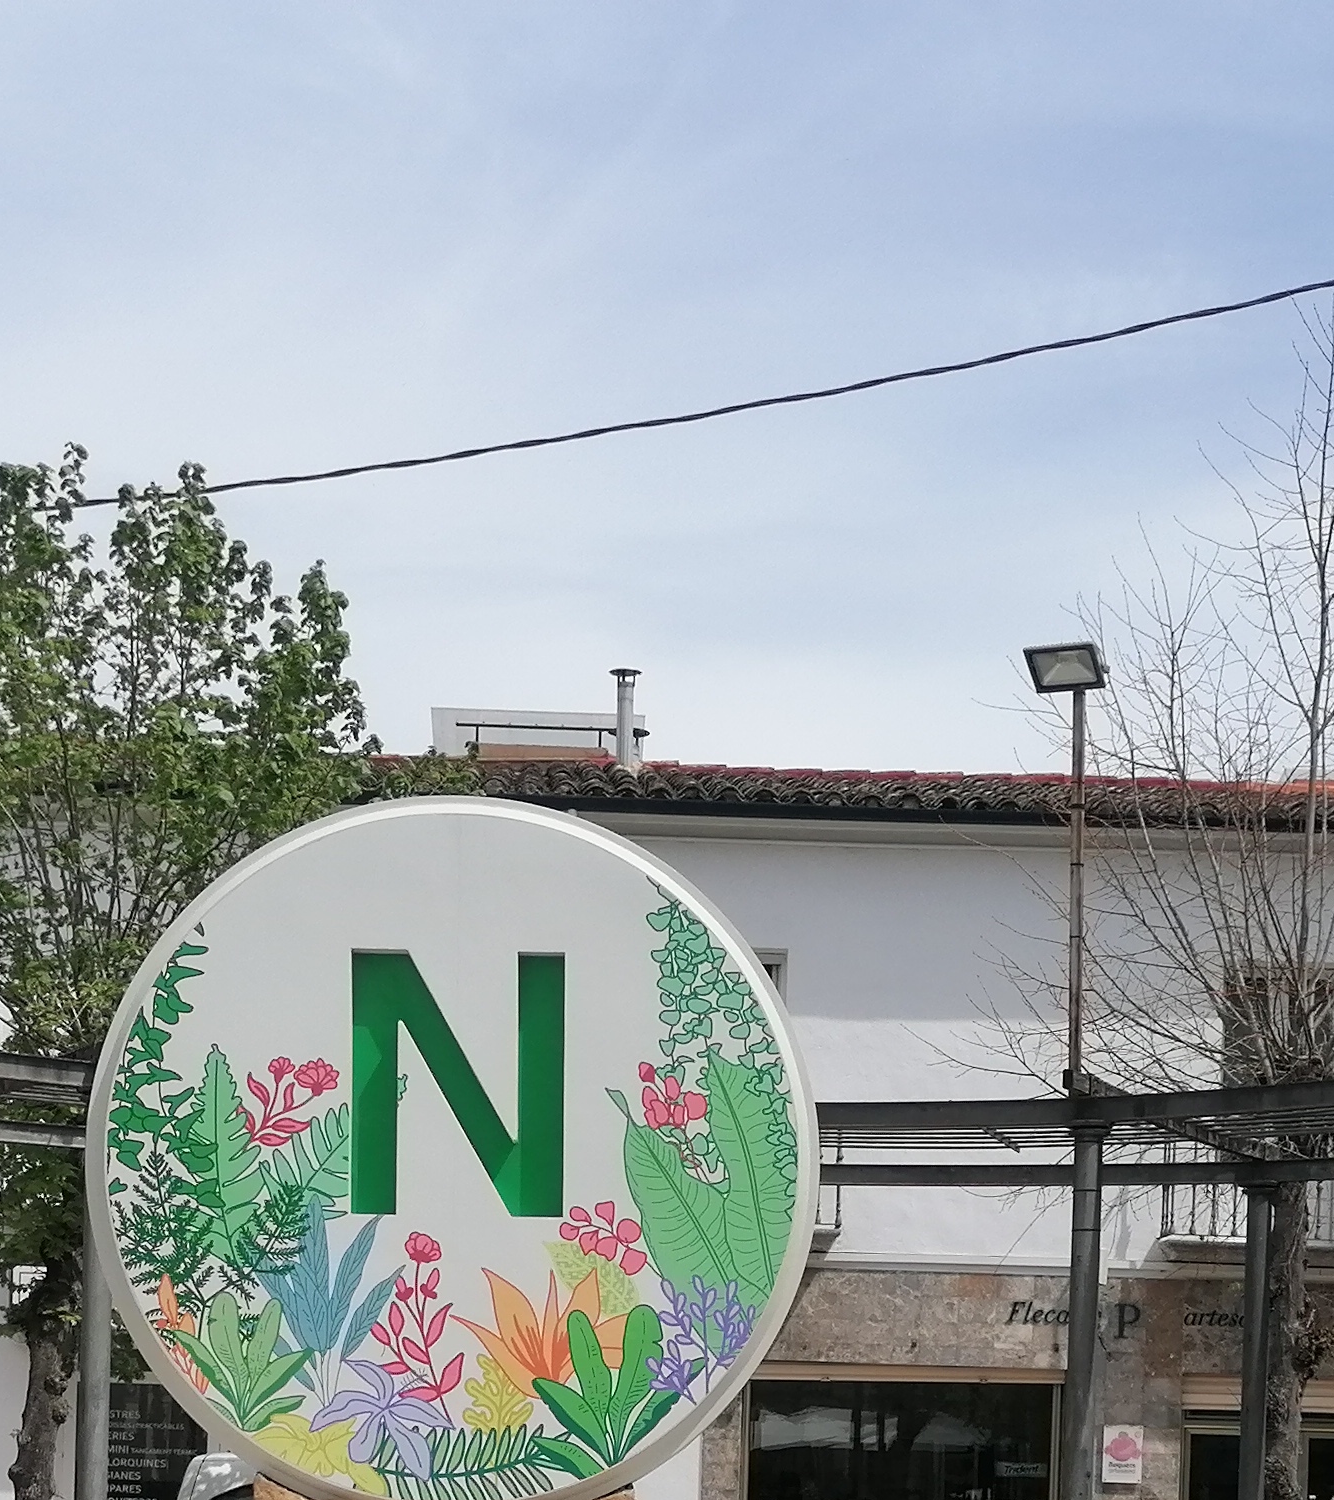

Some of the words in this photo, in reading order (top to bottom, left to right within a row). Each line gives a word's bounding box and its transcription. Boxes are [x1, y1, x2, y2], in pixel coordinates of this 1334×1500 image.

[350, 947, 565, 1217] N
[1114, 1303, 1141, 1339] P
[109, 1409, 141, 1420] STRES
[108, 1431, 135, 1441] ERIES
[108, 1445, 129, 1454] MINI
[107, 1458, 168, 1469] LORQUINES
[106, 1484, 142, 1495] PARES
